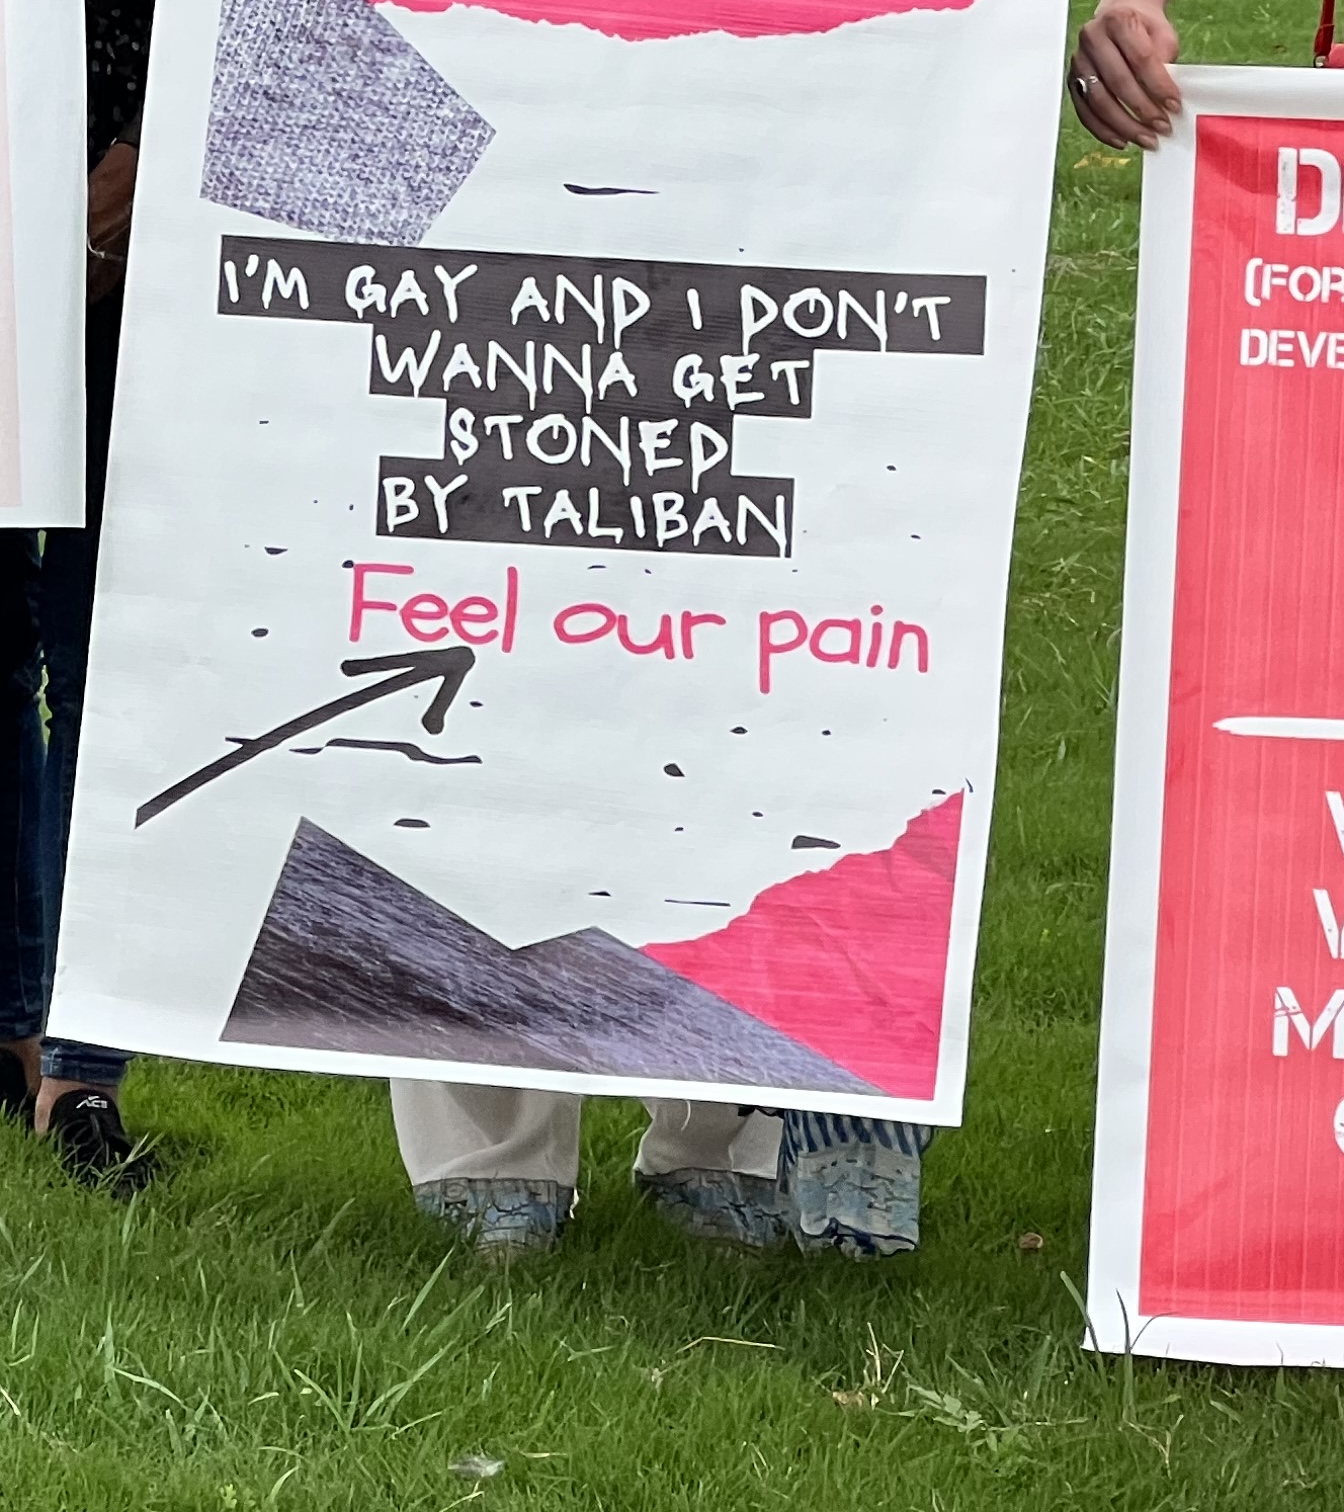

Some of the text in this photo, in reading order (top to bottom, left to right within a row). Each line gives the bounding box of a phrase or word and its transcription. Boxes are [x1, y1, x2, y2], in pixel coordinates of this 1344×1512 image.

[223, 254, 951, 351] I'M GAY AND I DON'T
[373, 330, 810, 412] WANNA GET
[449, 407, 730, 491] STONED
[383, 473, 788, 556] BY TALIBAN
[350, 563, 929, 693] Feel our pain
